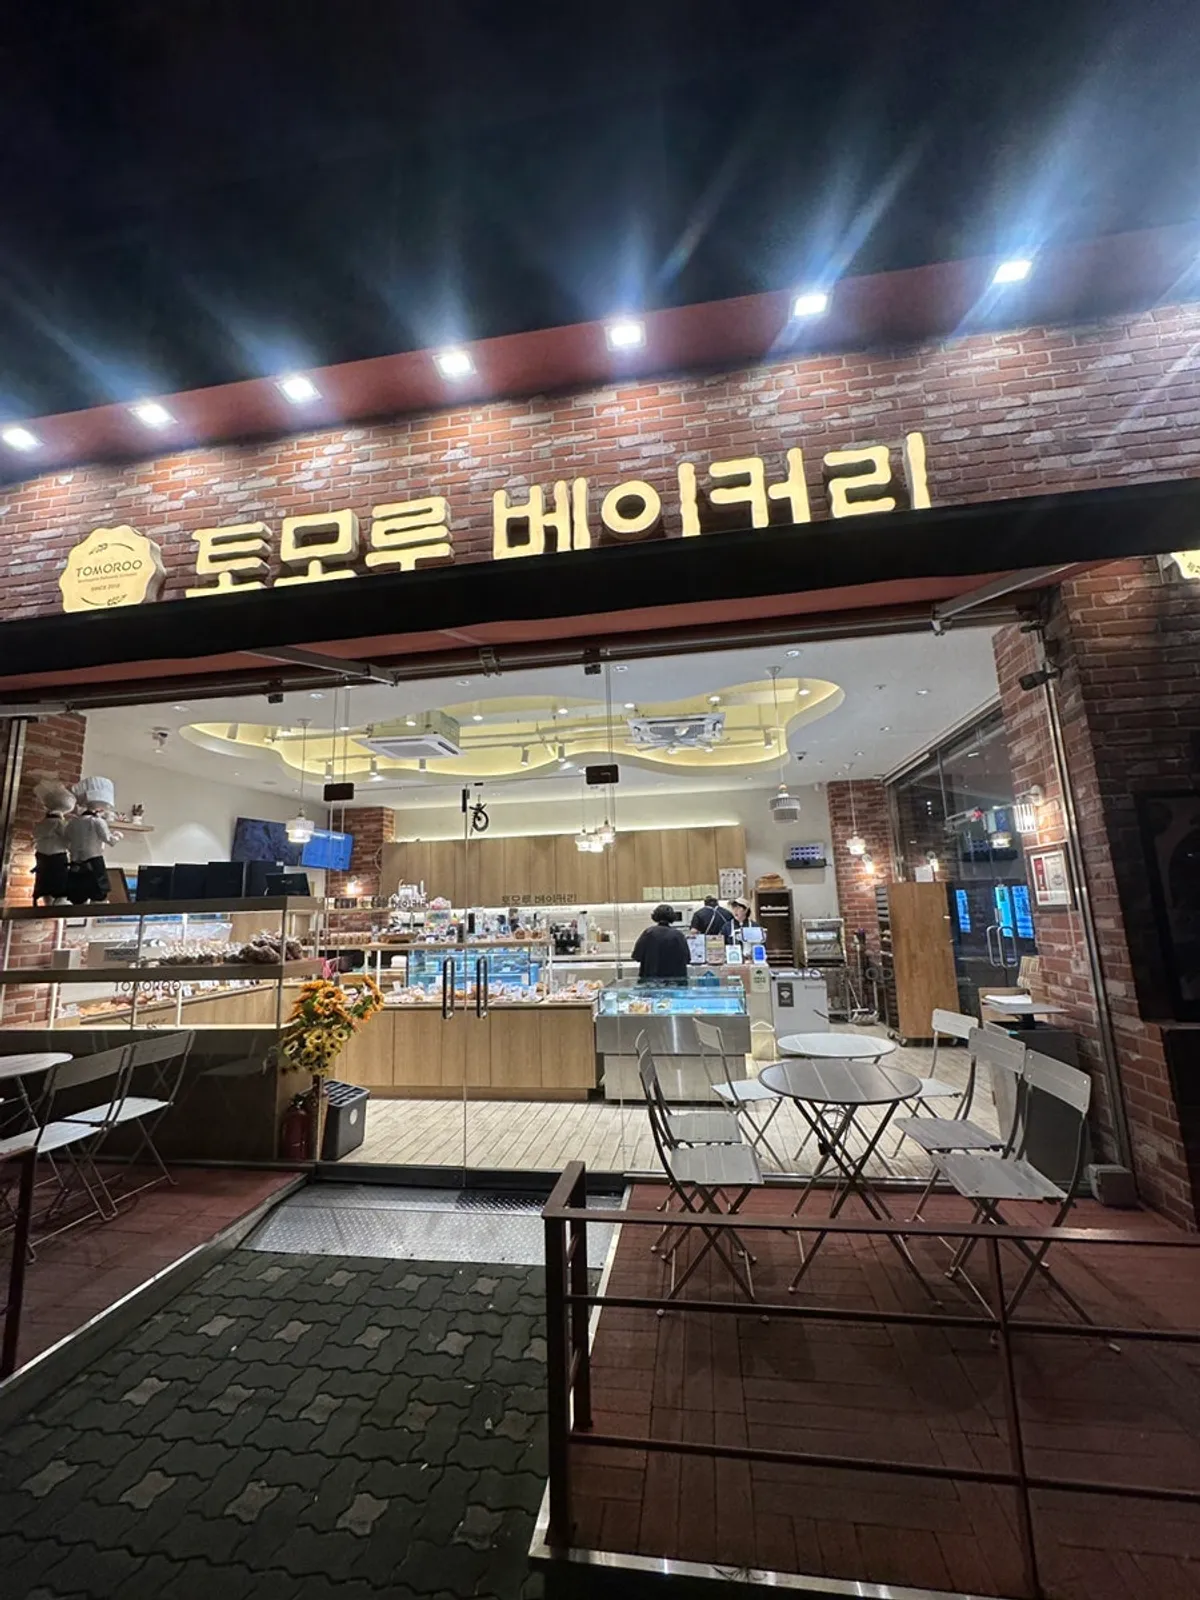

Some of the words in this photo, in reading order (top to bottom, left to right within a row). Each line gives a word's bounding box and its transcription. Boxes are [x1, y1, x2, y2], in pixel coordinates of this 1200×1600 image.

[185, 496, 451, 598] 토모루
[493, 432, 931, 559] 베이커리
[76, 559, 143, 578] TOMOROO
